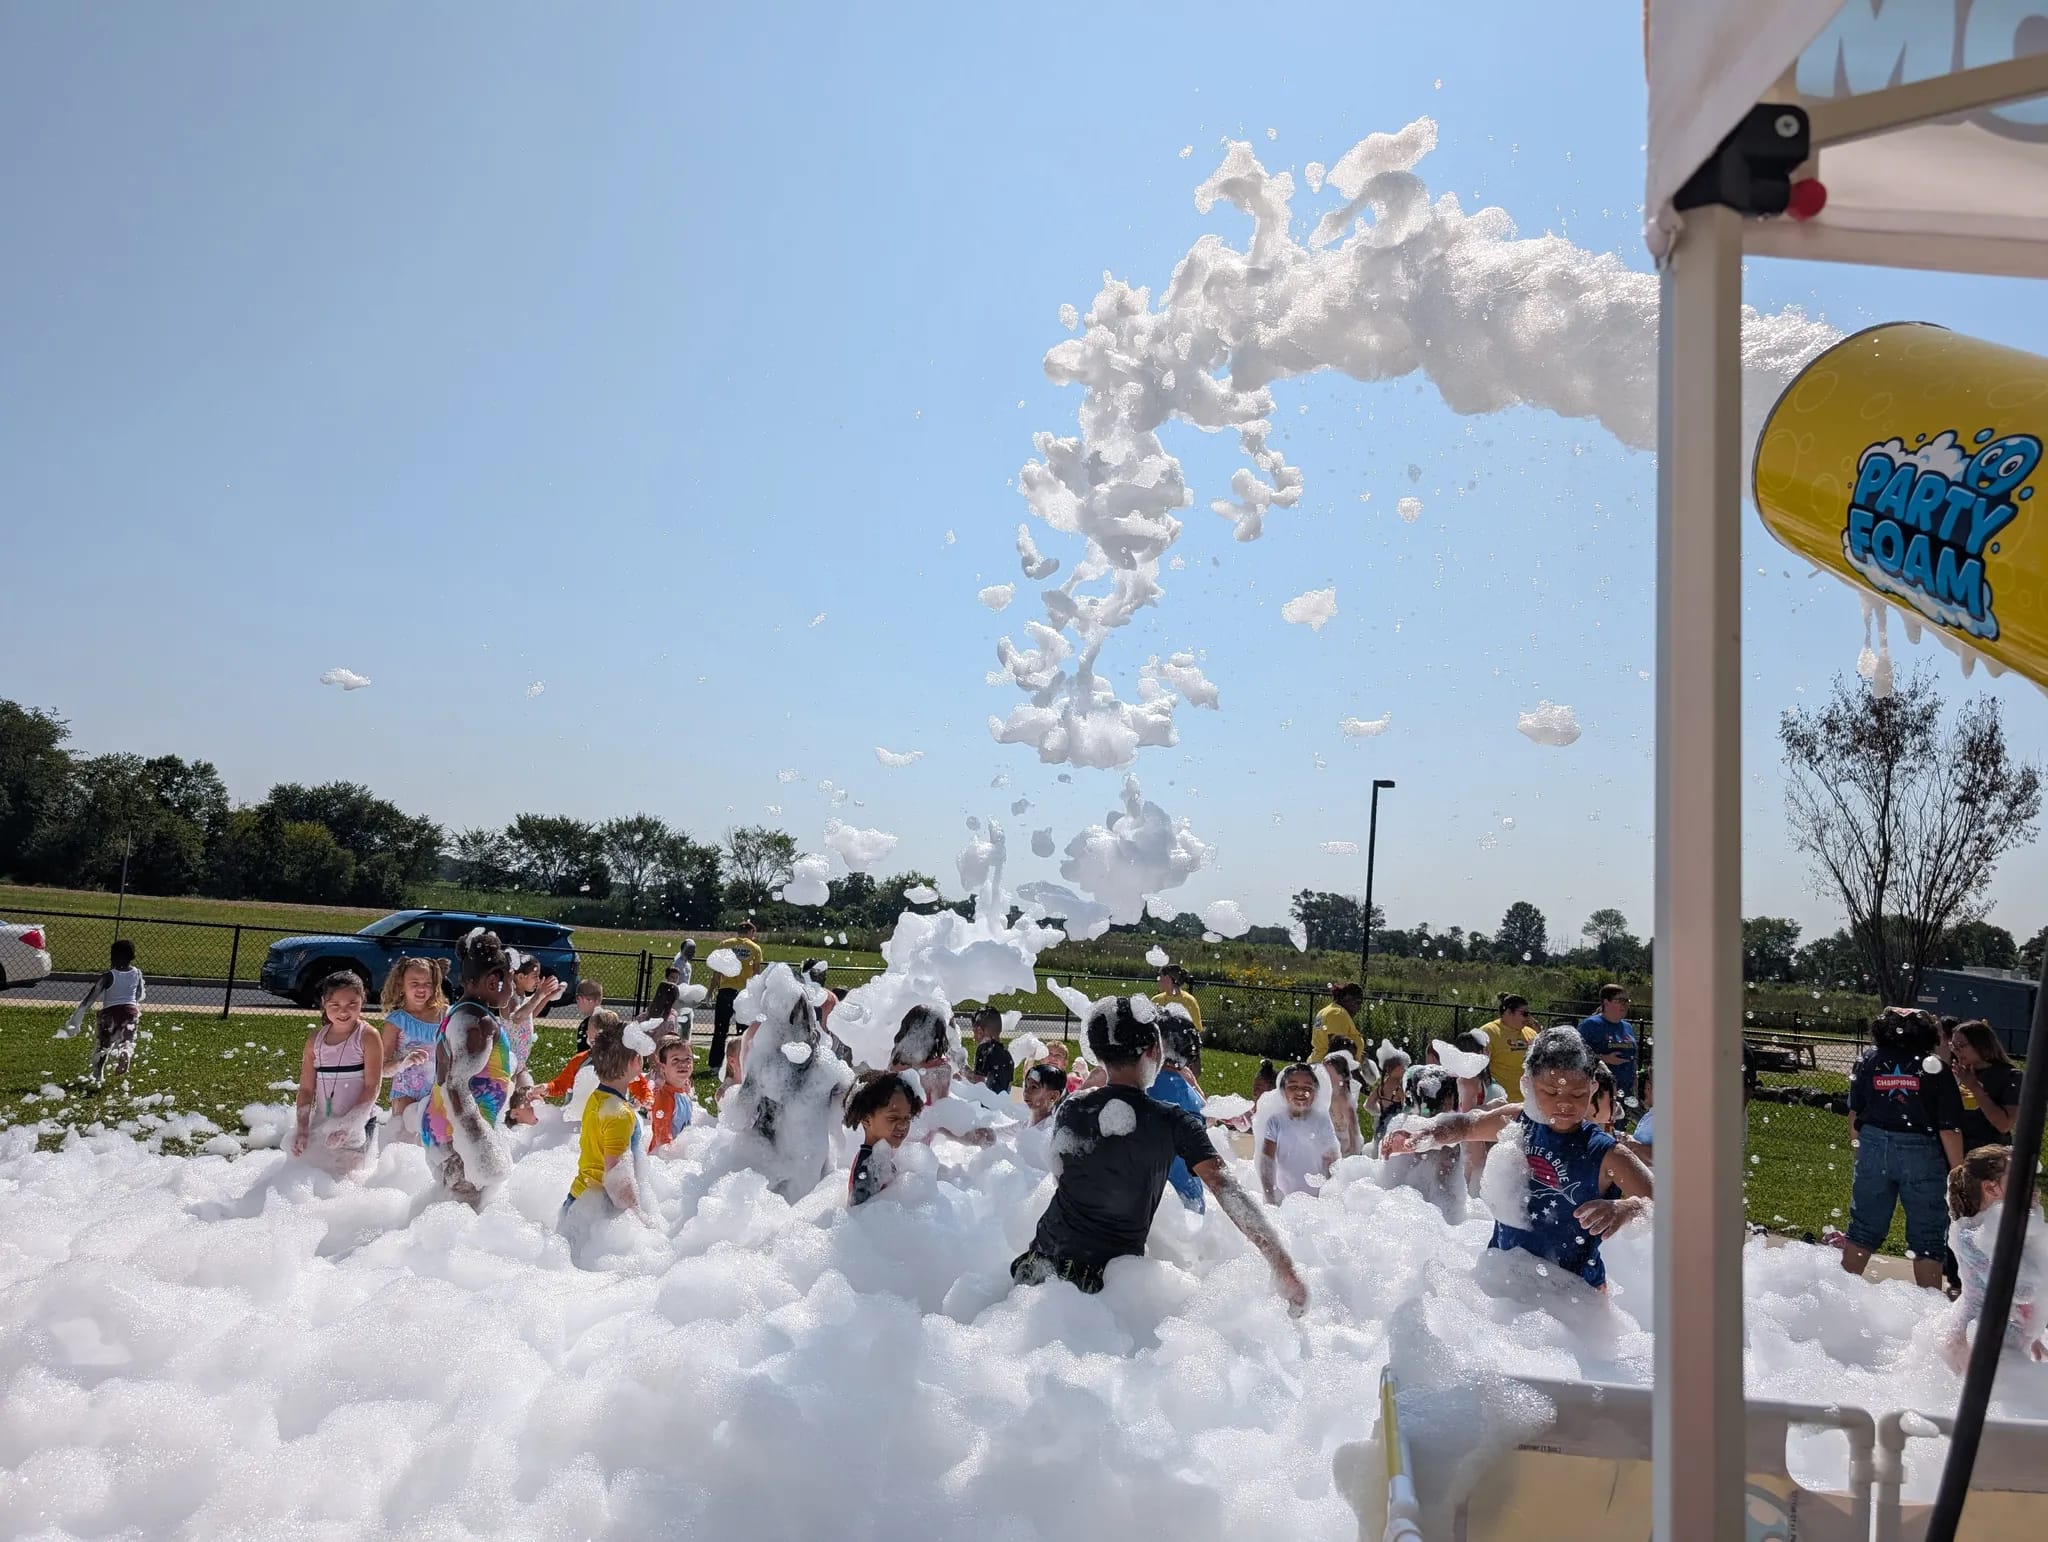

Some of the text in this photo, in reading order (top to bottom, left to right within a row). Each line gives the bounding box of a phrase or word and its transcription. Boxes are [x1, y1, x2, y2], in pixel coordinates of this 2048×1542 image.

[1854, 454, 2014, 555] PARTY
[1850, 507, 1985, 620] FOAM
[1876, 1079, 1917, 1087] CHAMPIONS
[1525, 1145, 1570, 1184] BITE & BLUE
